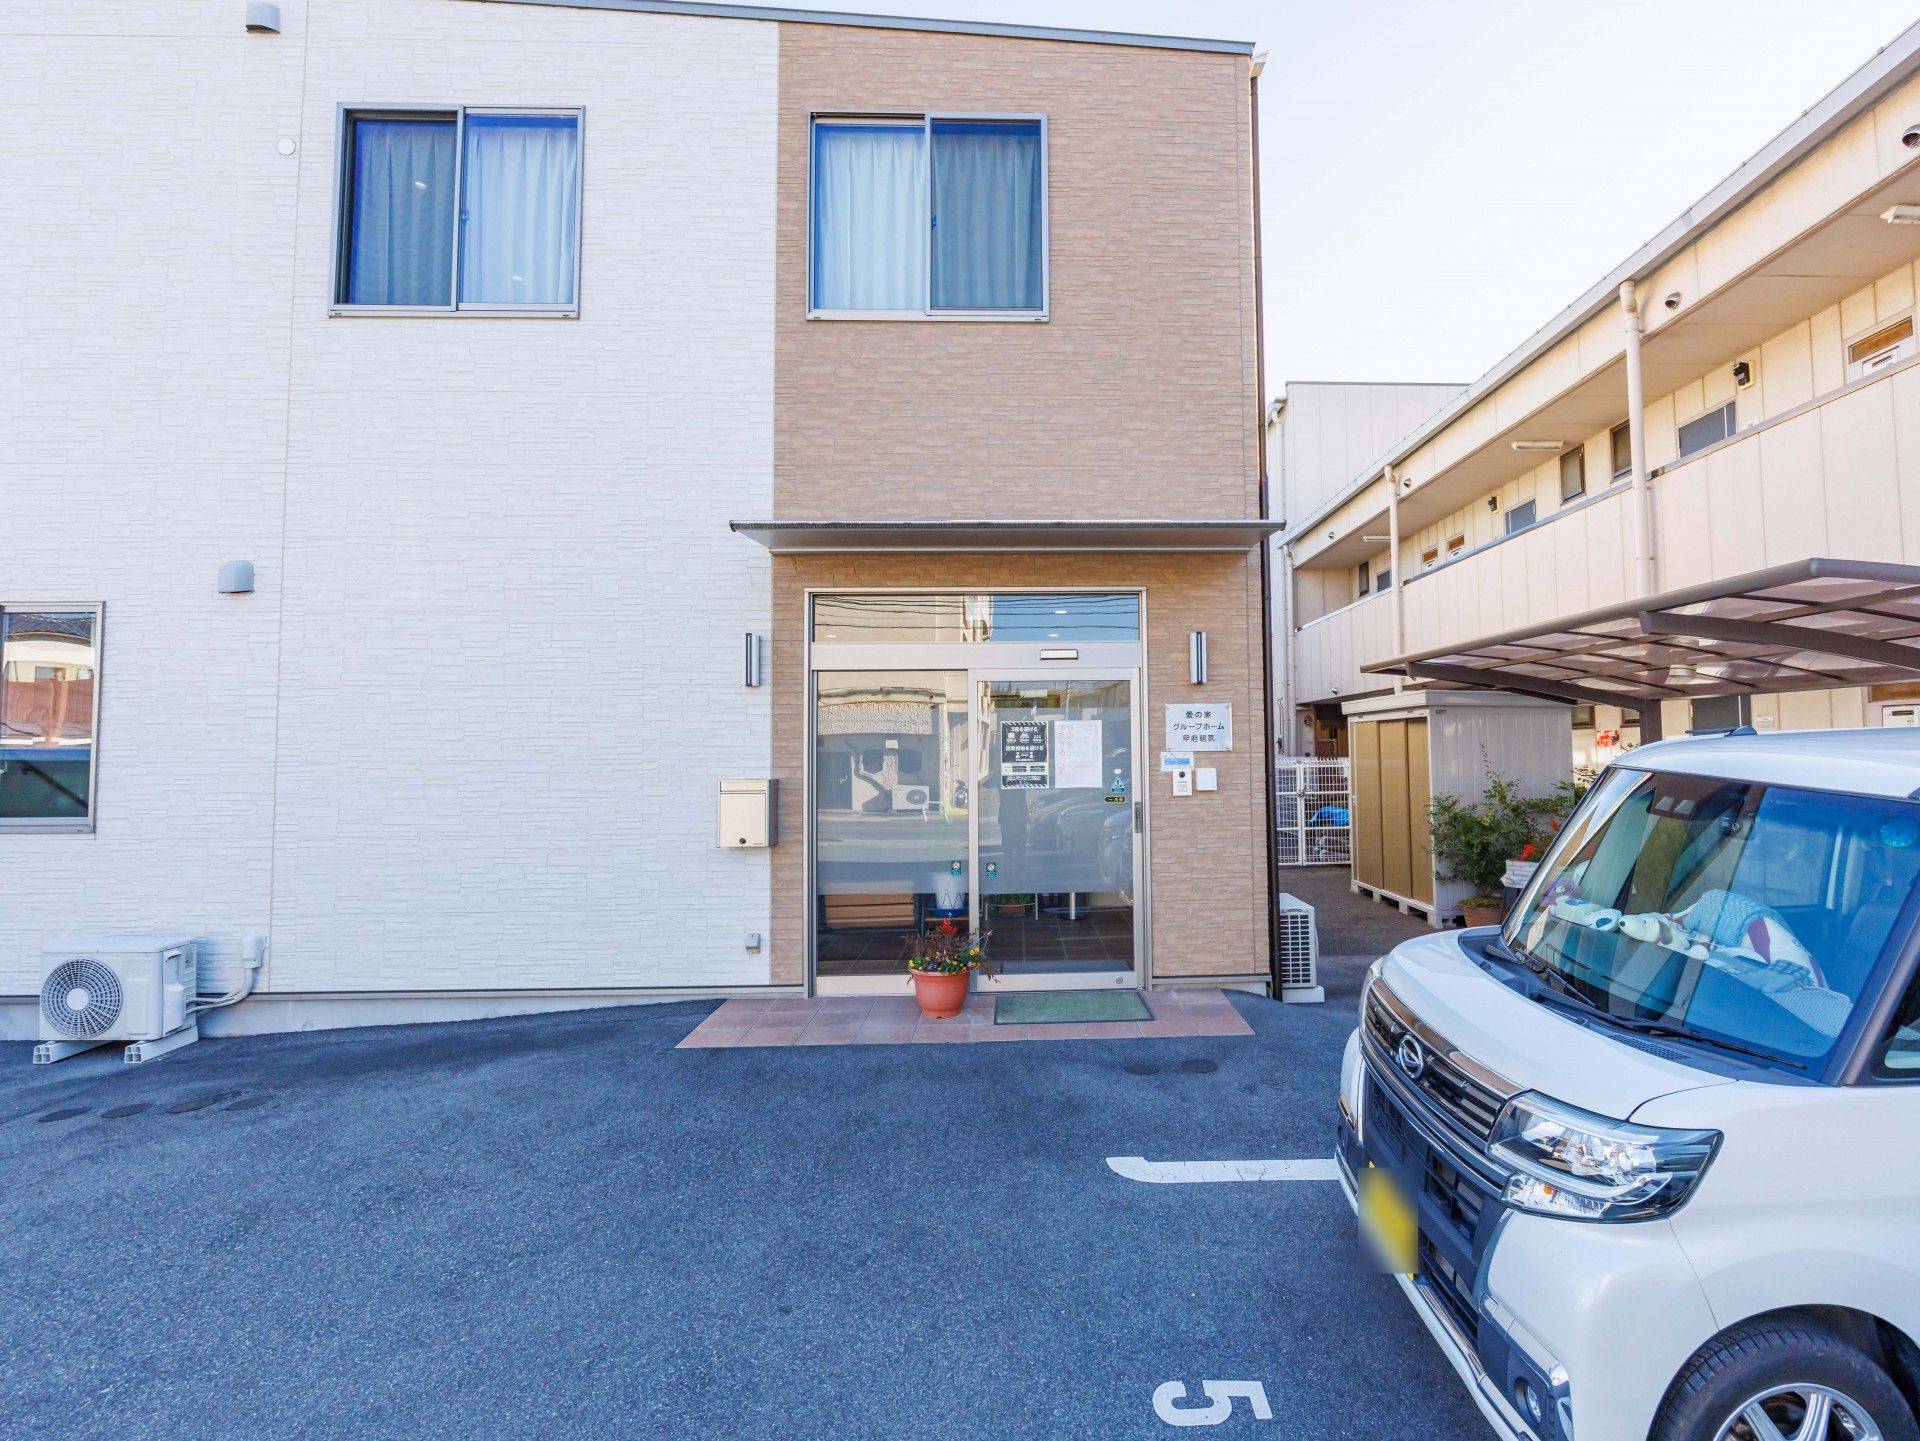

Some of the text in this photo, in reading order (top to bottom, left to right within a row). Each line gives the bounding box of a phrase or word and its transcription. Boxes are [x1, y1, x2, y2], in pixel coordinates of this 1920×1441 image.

[1186, 711, 1212, 719] 愛の家
[1152, 1380, 1273, 1426] 5
